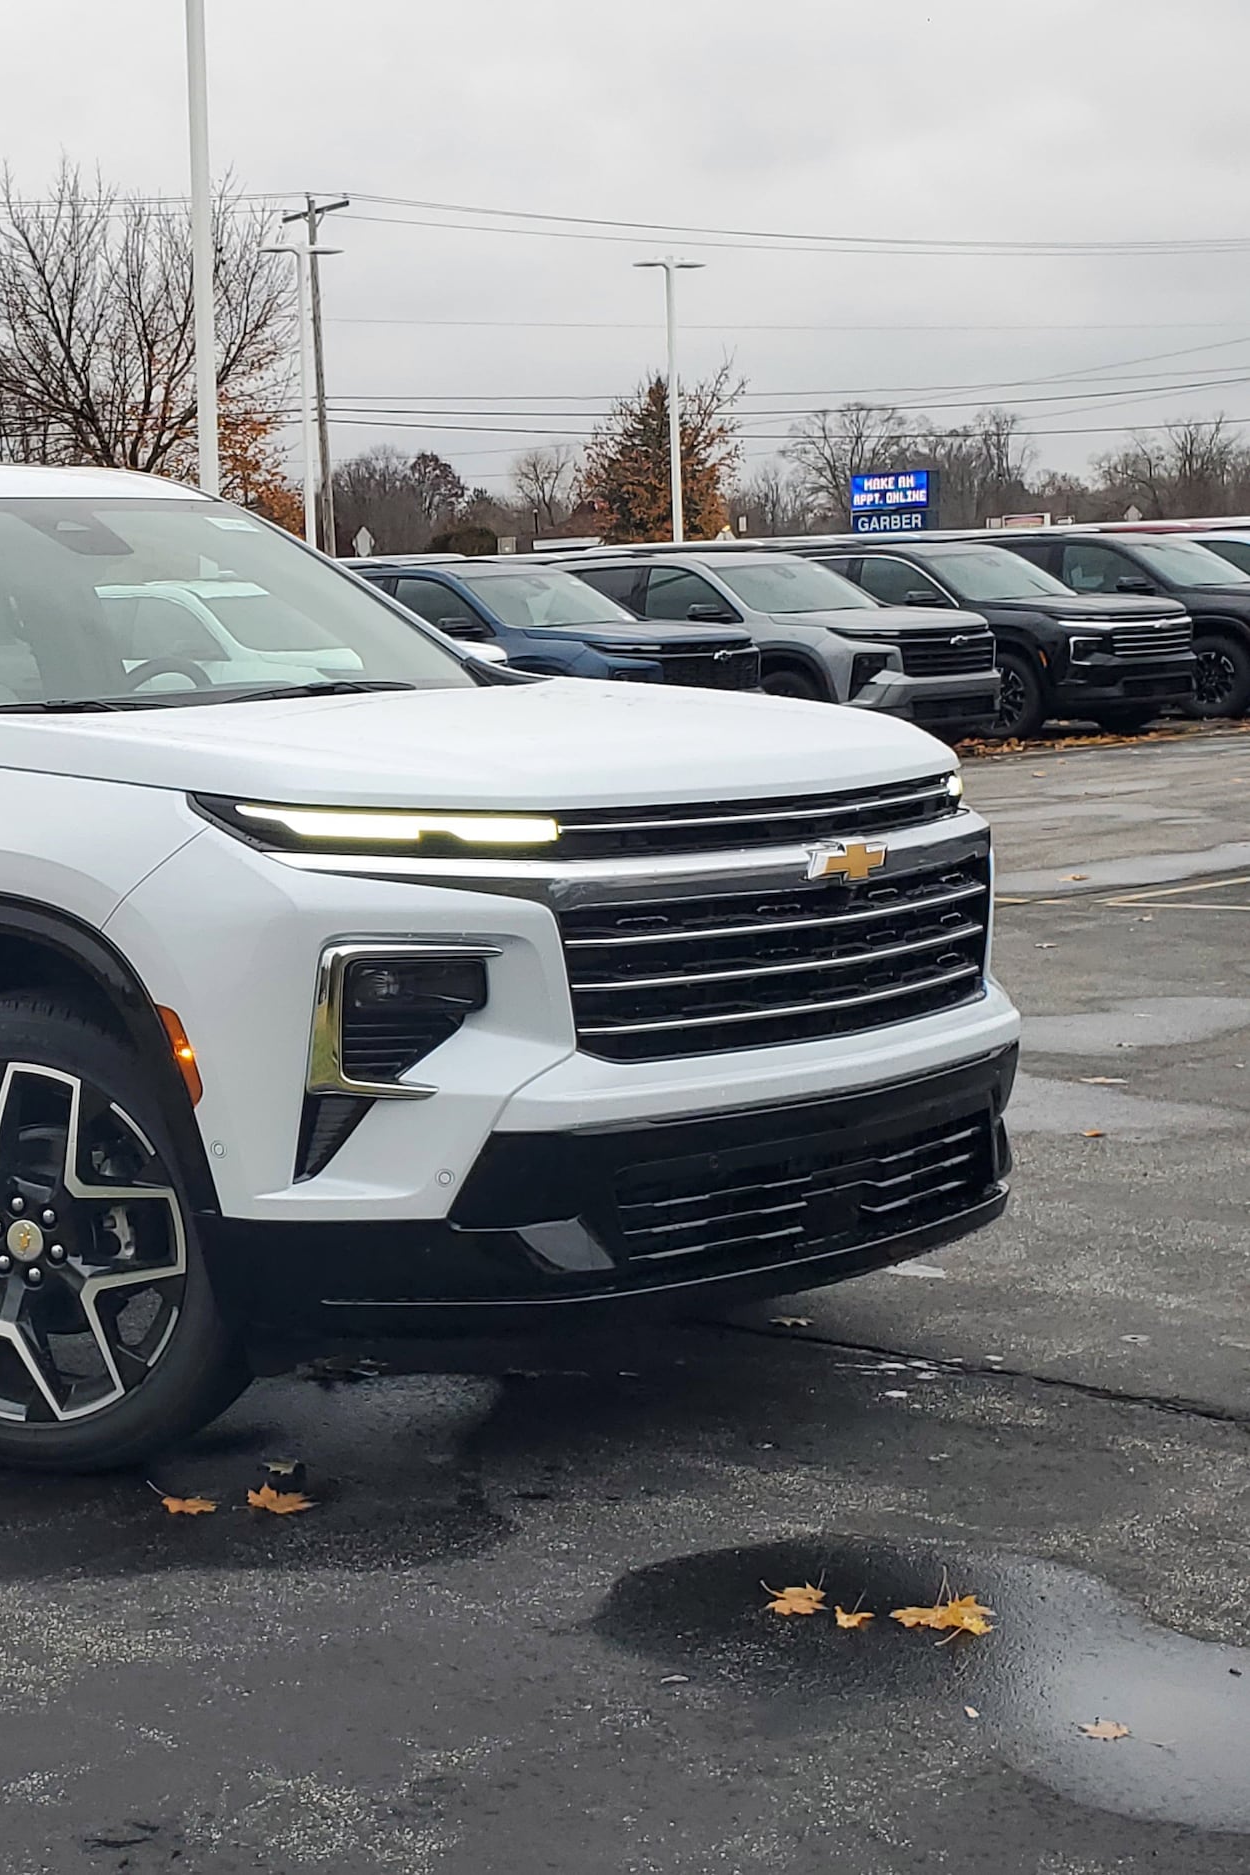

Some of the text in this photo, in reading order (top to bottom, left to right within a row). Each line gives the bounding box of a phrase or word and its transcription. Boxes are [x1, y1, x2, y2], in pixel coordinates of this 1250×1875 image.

[864, 475, 914, 491] MAKE AN
[854, 490, 927, 505] APPT. ONLINE
[858, 514, 922, 531] GARBER
